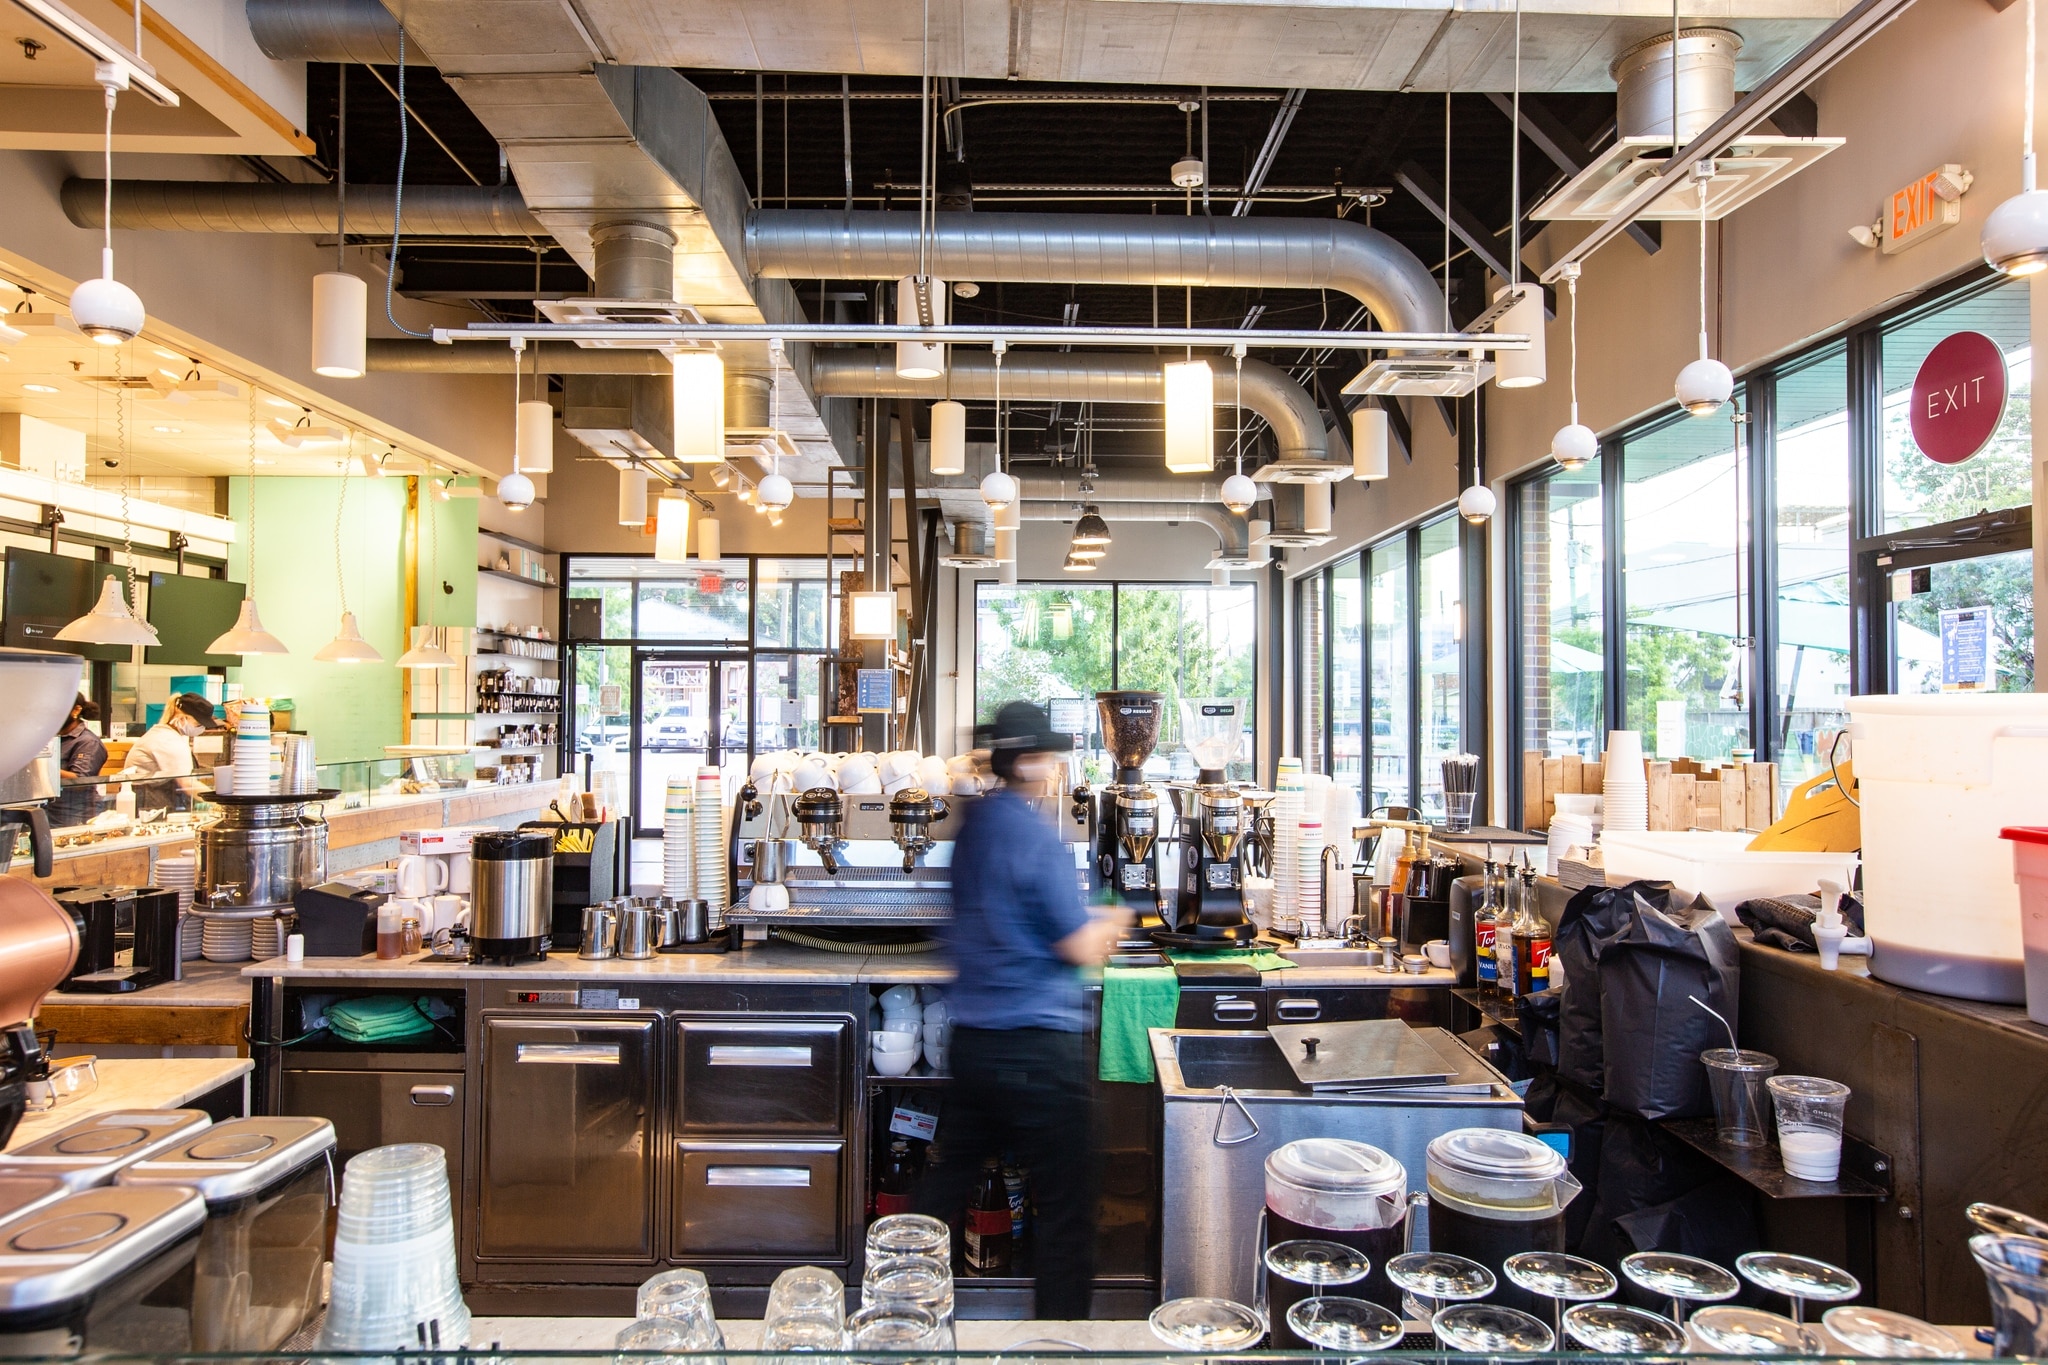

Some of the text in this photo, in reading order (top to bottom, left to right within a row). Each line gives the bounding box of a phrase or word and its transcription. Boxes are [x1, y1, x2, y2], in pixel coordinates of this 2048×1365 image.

[1892, 171, 1938, 240] EXIT
[1928, 376, 1985, 419] EXIT
[1479, 930, 1496, 949] Tor
